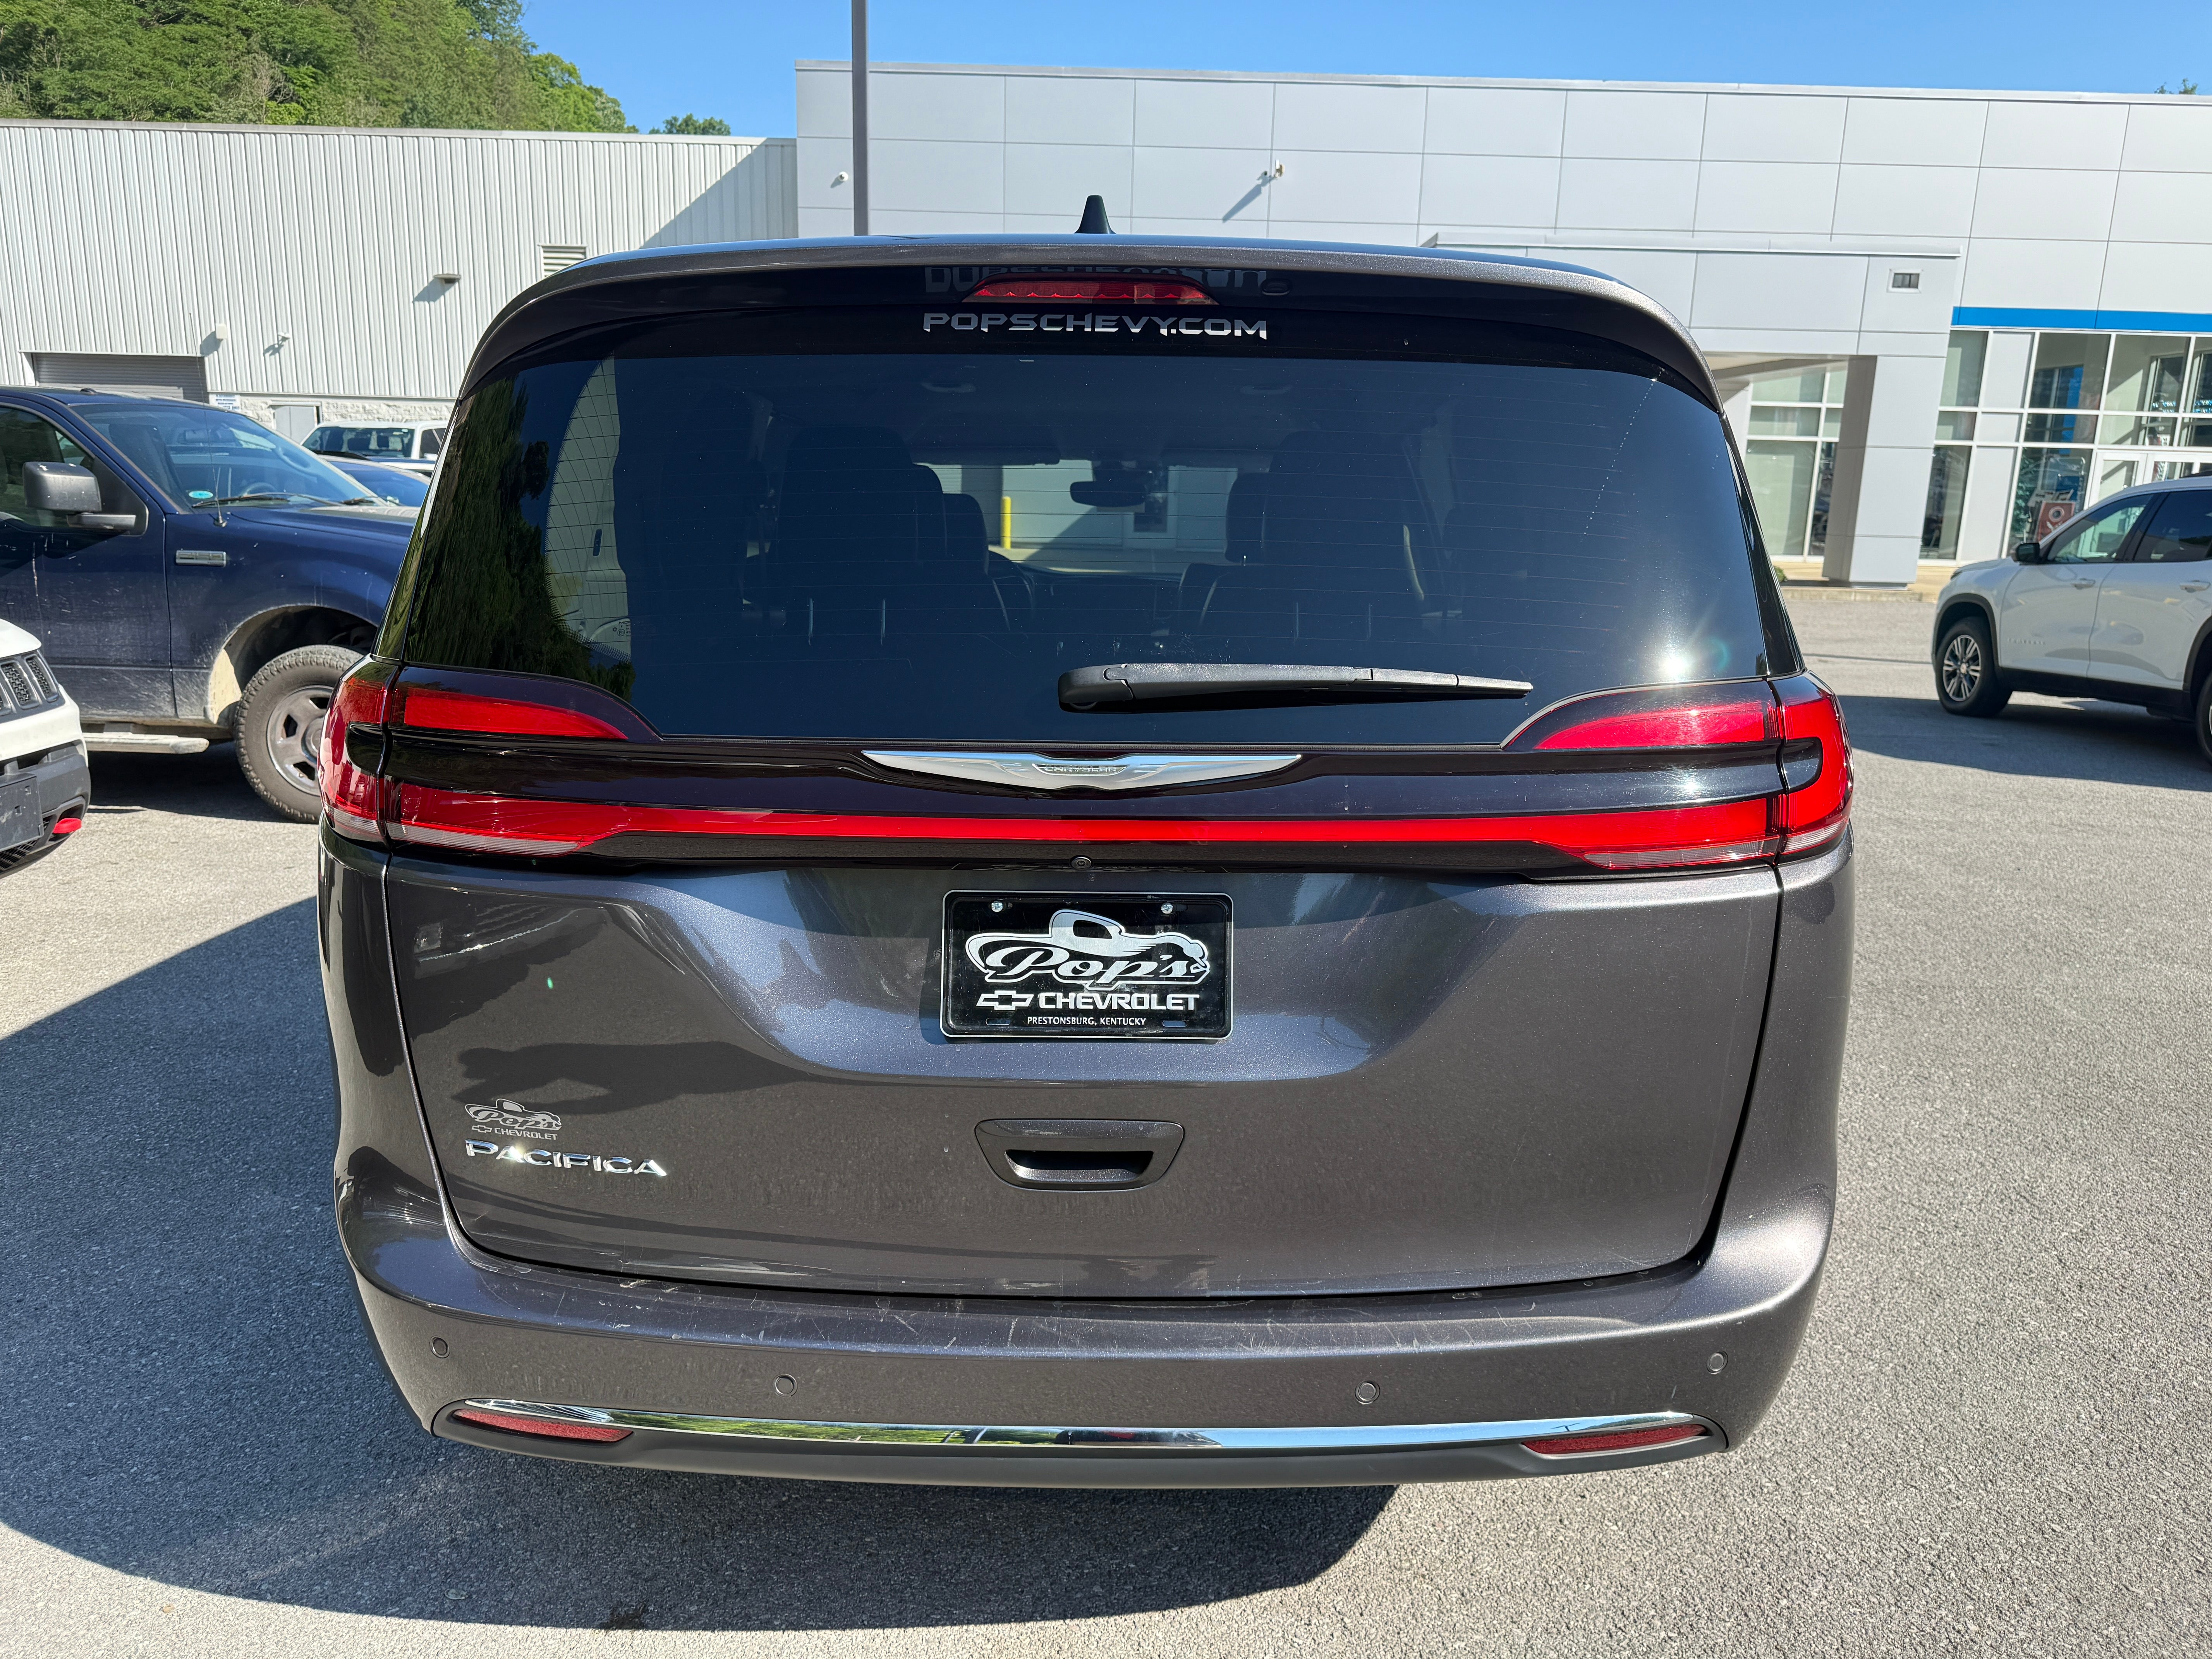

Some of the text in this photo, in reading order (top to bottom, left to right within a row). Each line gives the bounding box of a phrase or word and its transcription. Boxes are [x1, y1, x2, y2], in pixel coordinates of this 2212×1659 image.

[923, 313, 1267, 340] POPSCHEVY.COM
[986, 946, 1196, 984] Pop's
[1039, 993, 1199, 1010] CHEVROLET
[1027, 1016, 1146, 1026] PRESTONSBURG, KENTUCKY
[495, 1128, 558, 1140] CHEVROLET
[465, 1139, 667, 1176] PACIFICA
